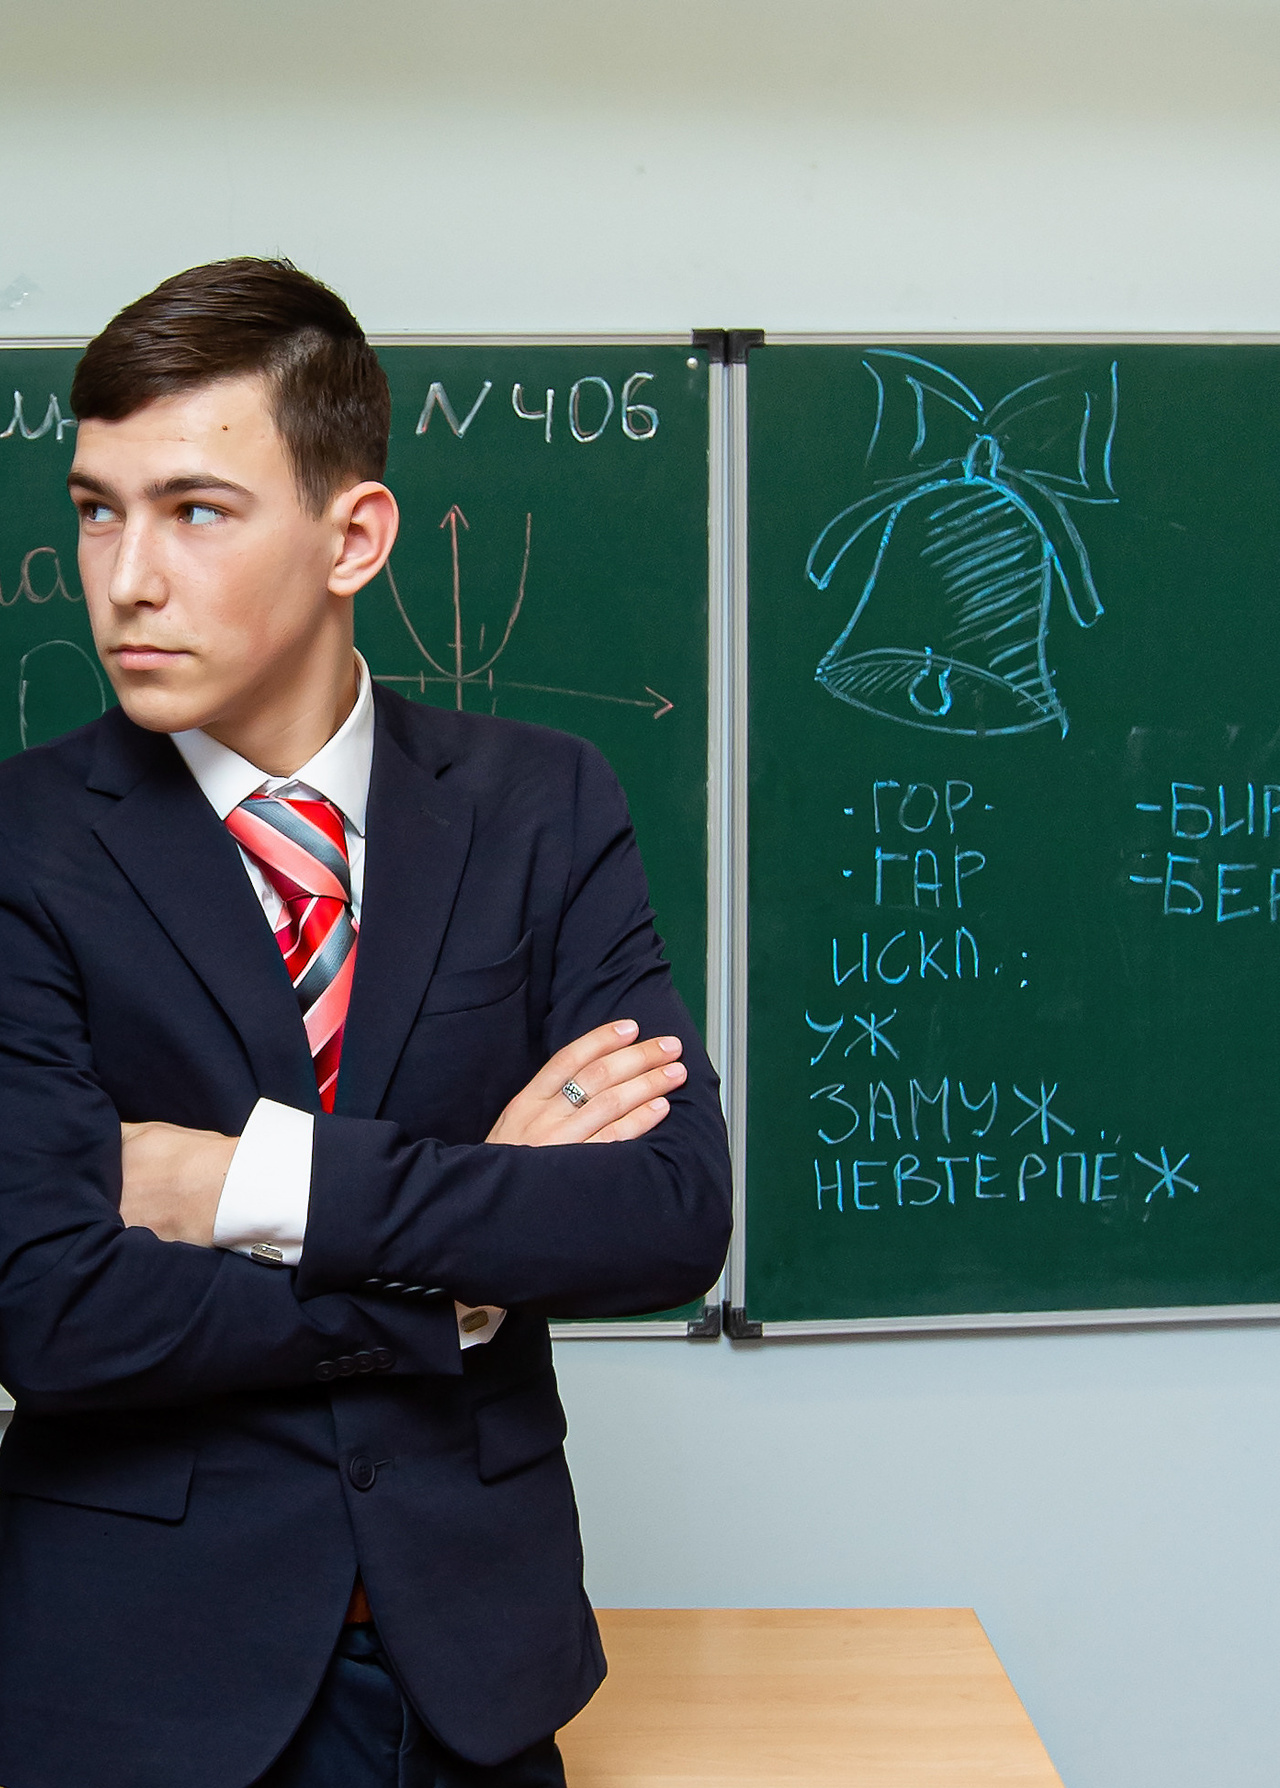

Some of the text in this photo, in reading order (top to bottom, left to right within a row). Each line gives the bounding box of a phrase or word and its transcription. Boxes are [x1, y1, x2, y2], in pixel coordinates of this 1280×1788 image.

[512, 371, 660, 443] 406
[805, 1008, 900, 1066] УЖ
[810, 1076, 1076, 1145] ЗАМУЖ
